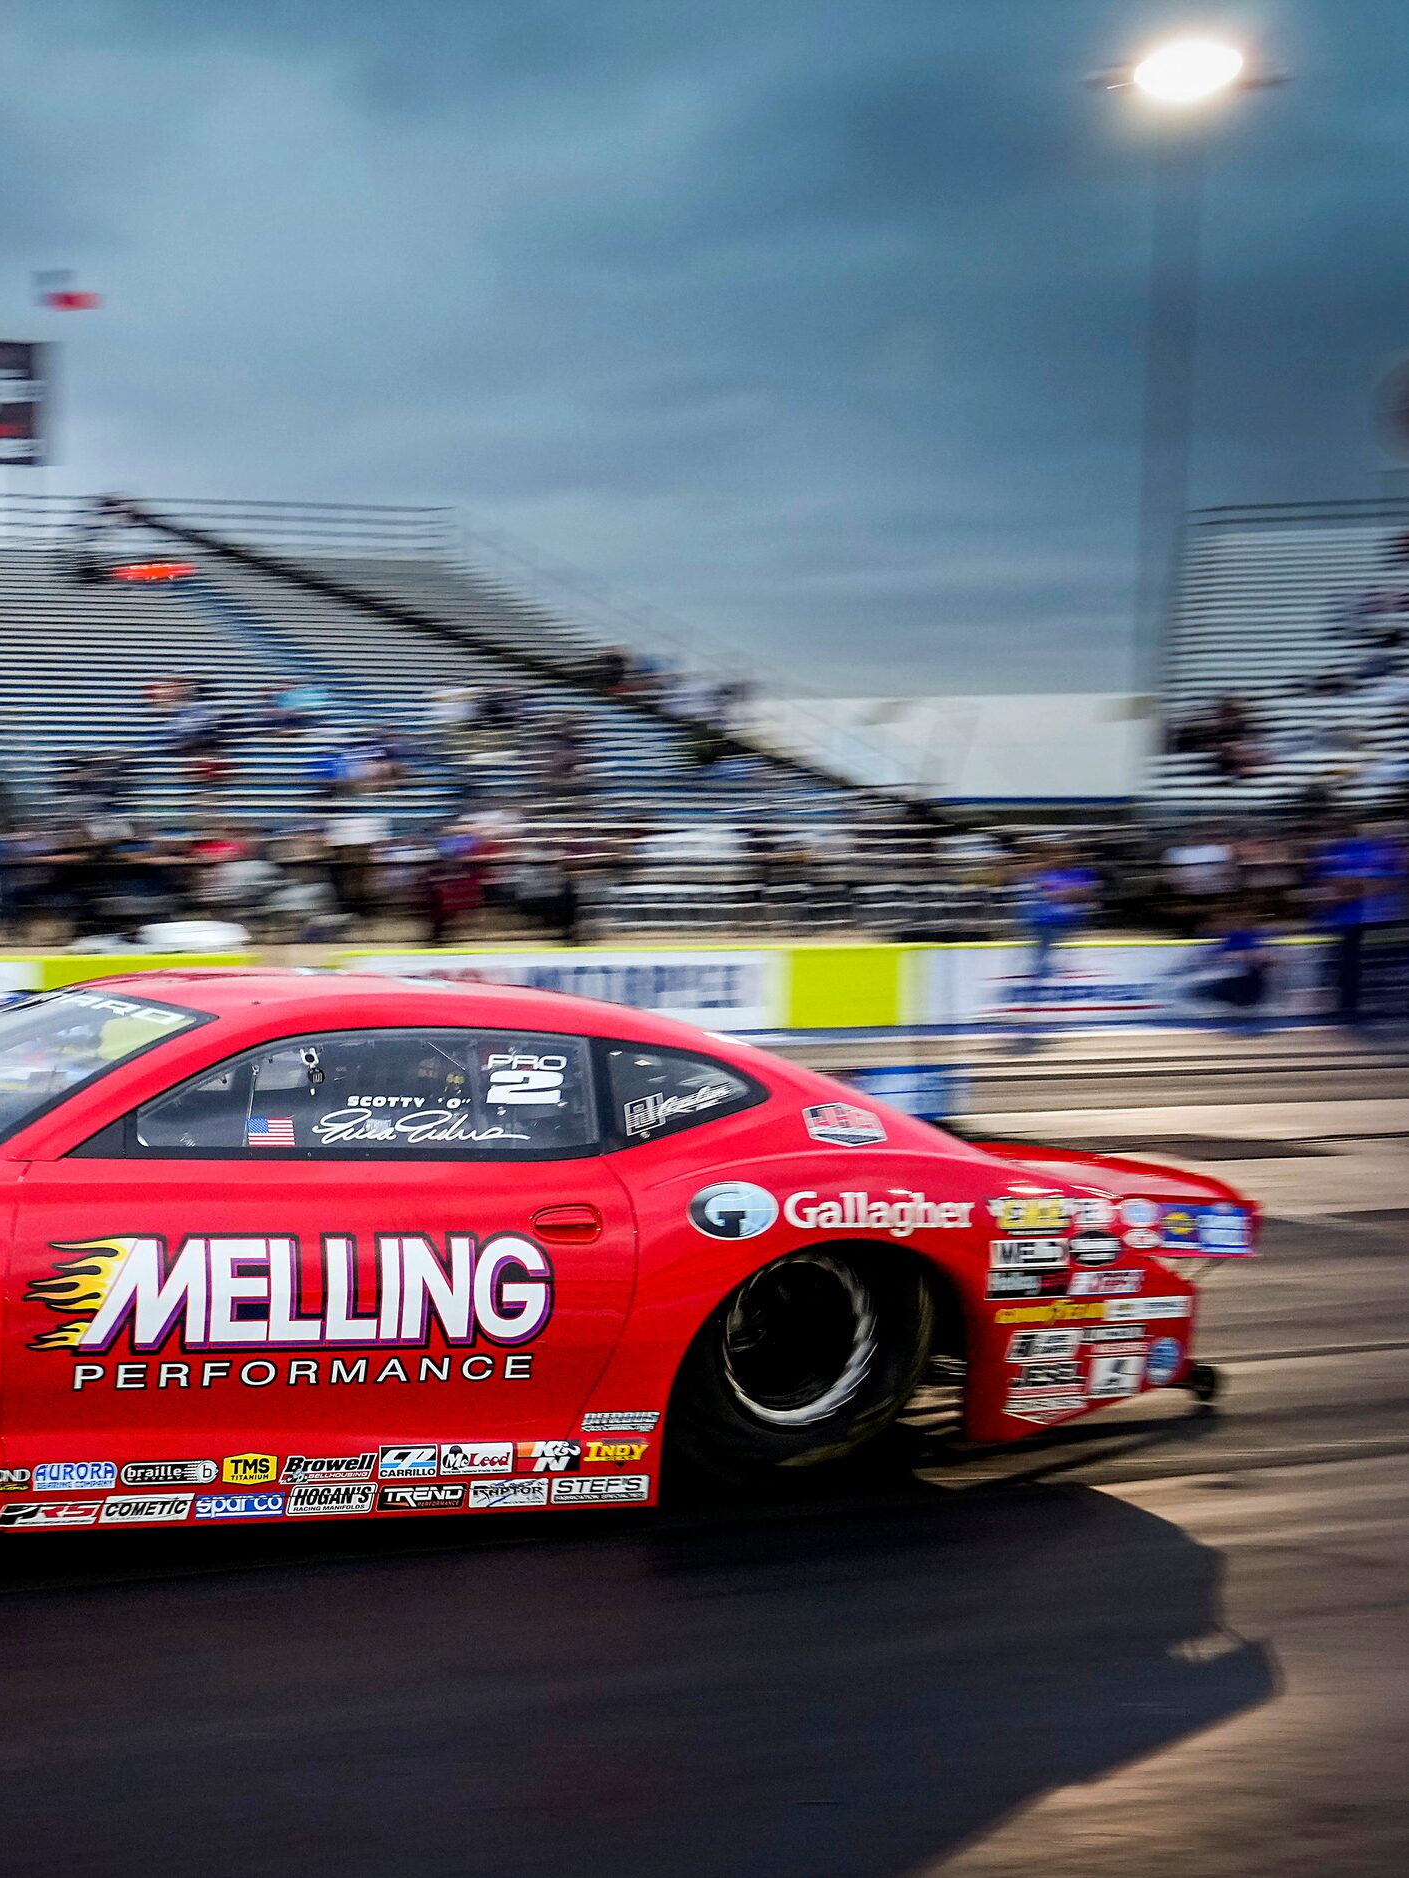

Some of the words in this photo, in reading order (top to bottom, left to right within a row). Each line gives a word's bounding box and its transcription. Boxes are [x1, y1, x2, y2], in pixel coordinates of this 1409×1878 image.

[487, 1054, 567, 1071] PRO
[486, 1070, 564, 1104] 2
[347, 1096, 425, 1108] SCOTTY
[783, 1191, 975, 1237] Gallagher
[80, 1236, 551, 1350] MELLING
[73, 1354, 534, 1390] PERFORMANCE
[381, 1448, 436, 1467] CP
[446, 1452, 511, 1469] McLeod
[584, 1442, 649, 1462] INDY
[35, 1462, 115, 1482] AURORA
[127, 1466, 182, 1478] braille
[231, 1458, 271, 1474] TMS
[284, 1455, 375, 1474] Browell
[380, 1469, 436, 1477] CARRILLO
[533, 1456, 570, 1472] N
[473, 1485, 544, 1500] RAPTOR
[556, 1478, 642, 1494] STEF'S
[294, 1487, 372, 1506] HOGAN'S
[384, 1486, 464, 1507] TREND
[105, 1500, 188, 1517] COMETIC
[196, 1496, 282, 1518] sparco
